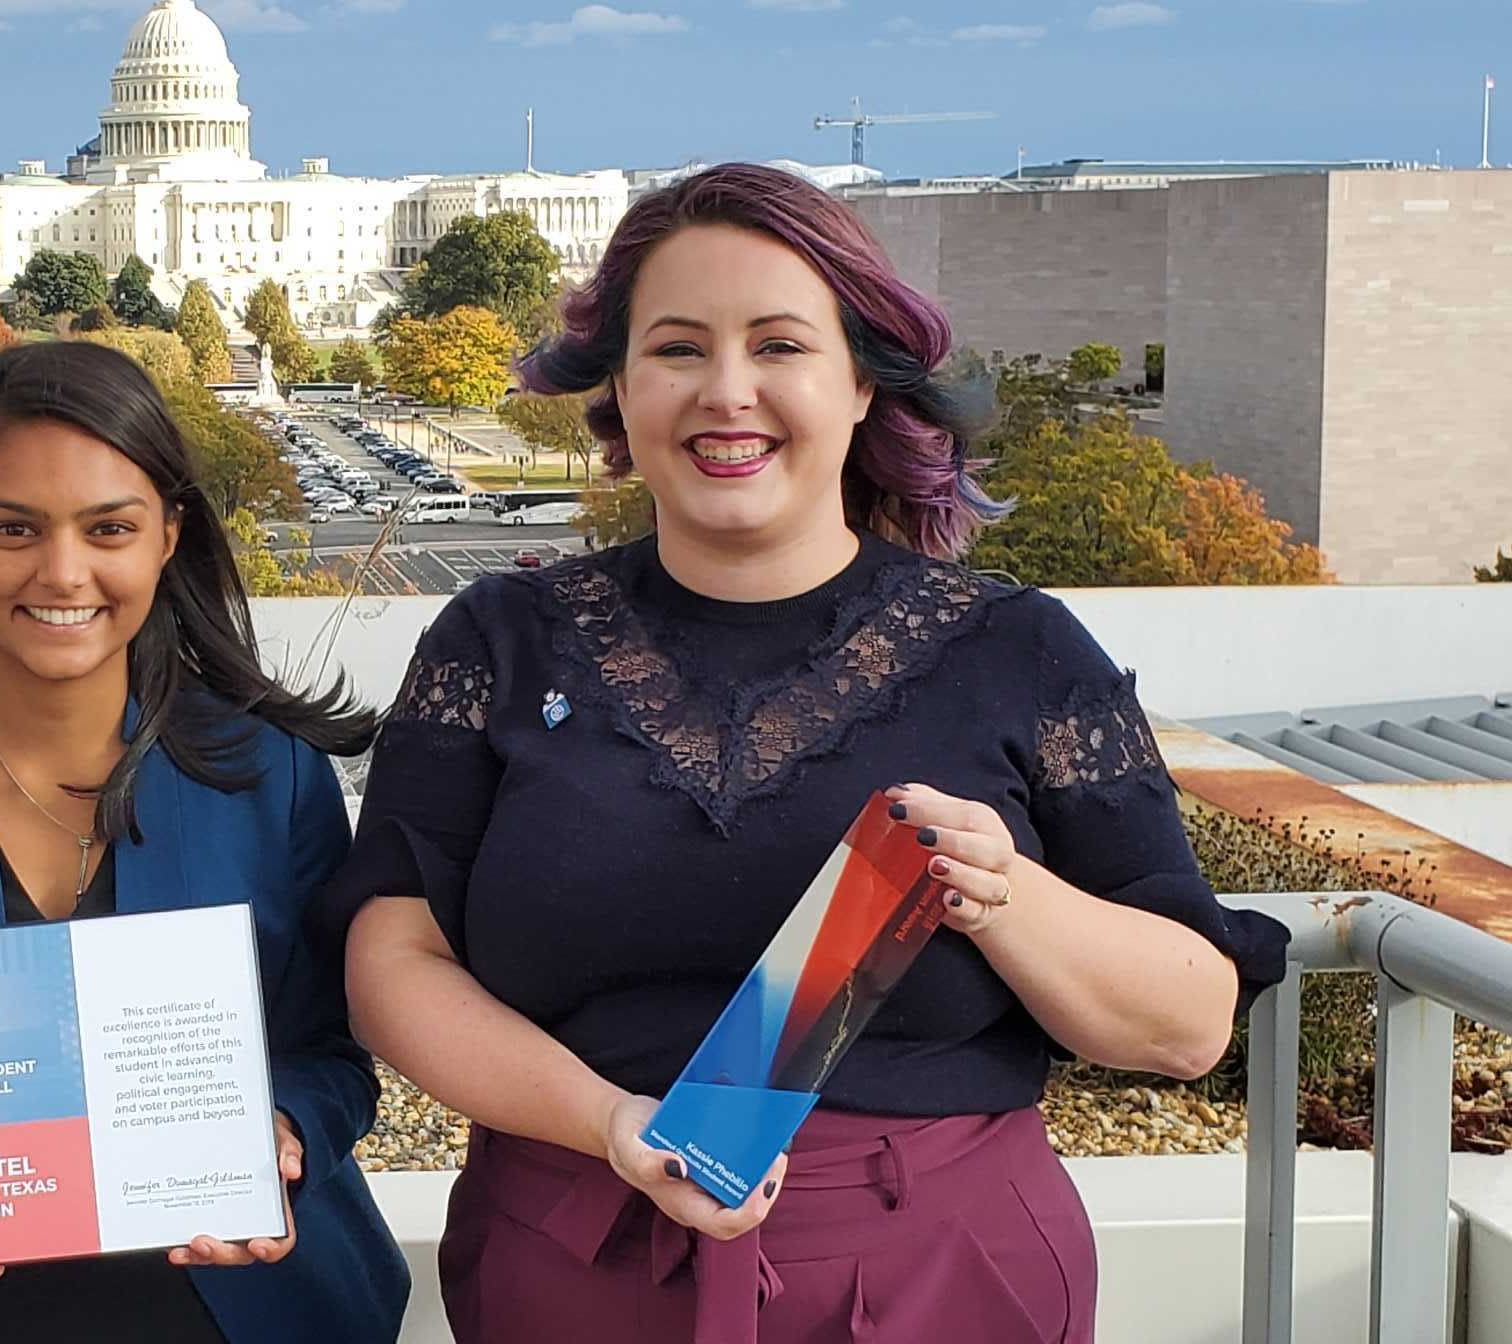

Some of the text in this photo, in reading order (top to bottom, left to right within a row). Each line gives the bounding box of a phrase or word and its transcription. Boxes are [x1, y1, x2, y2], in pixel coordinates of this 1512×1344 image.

[122, 998, 215, 1017] This certificate of
[103, 1011, 237, 1033] excellence is awarded in
[122, 1026, 221, 1045] recognition of the
[103, 1037, 242, 1060] remarkable efforts of this
[115, 1053, 233, 1072] student in advancing
[139, 1073, 165, 1084] civic
[115, 1093, 243, 1114] and voter participation
[116, 1087, 161, 1102] political
[112, 1119, 127, 1128] on
[130, 1113, 175, 1126] campus
[178, 1110, 200, 1121] and
[0, 1178, 57, 1196] TEXAS
